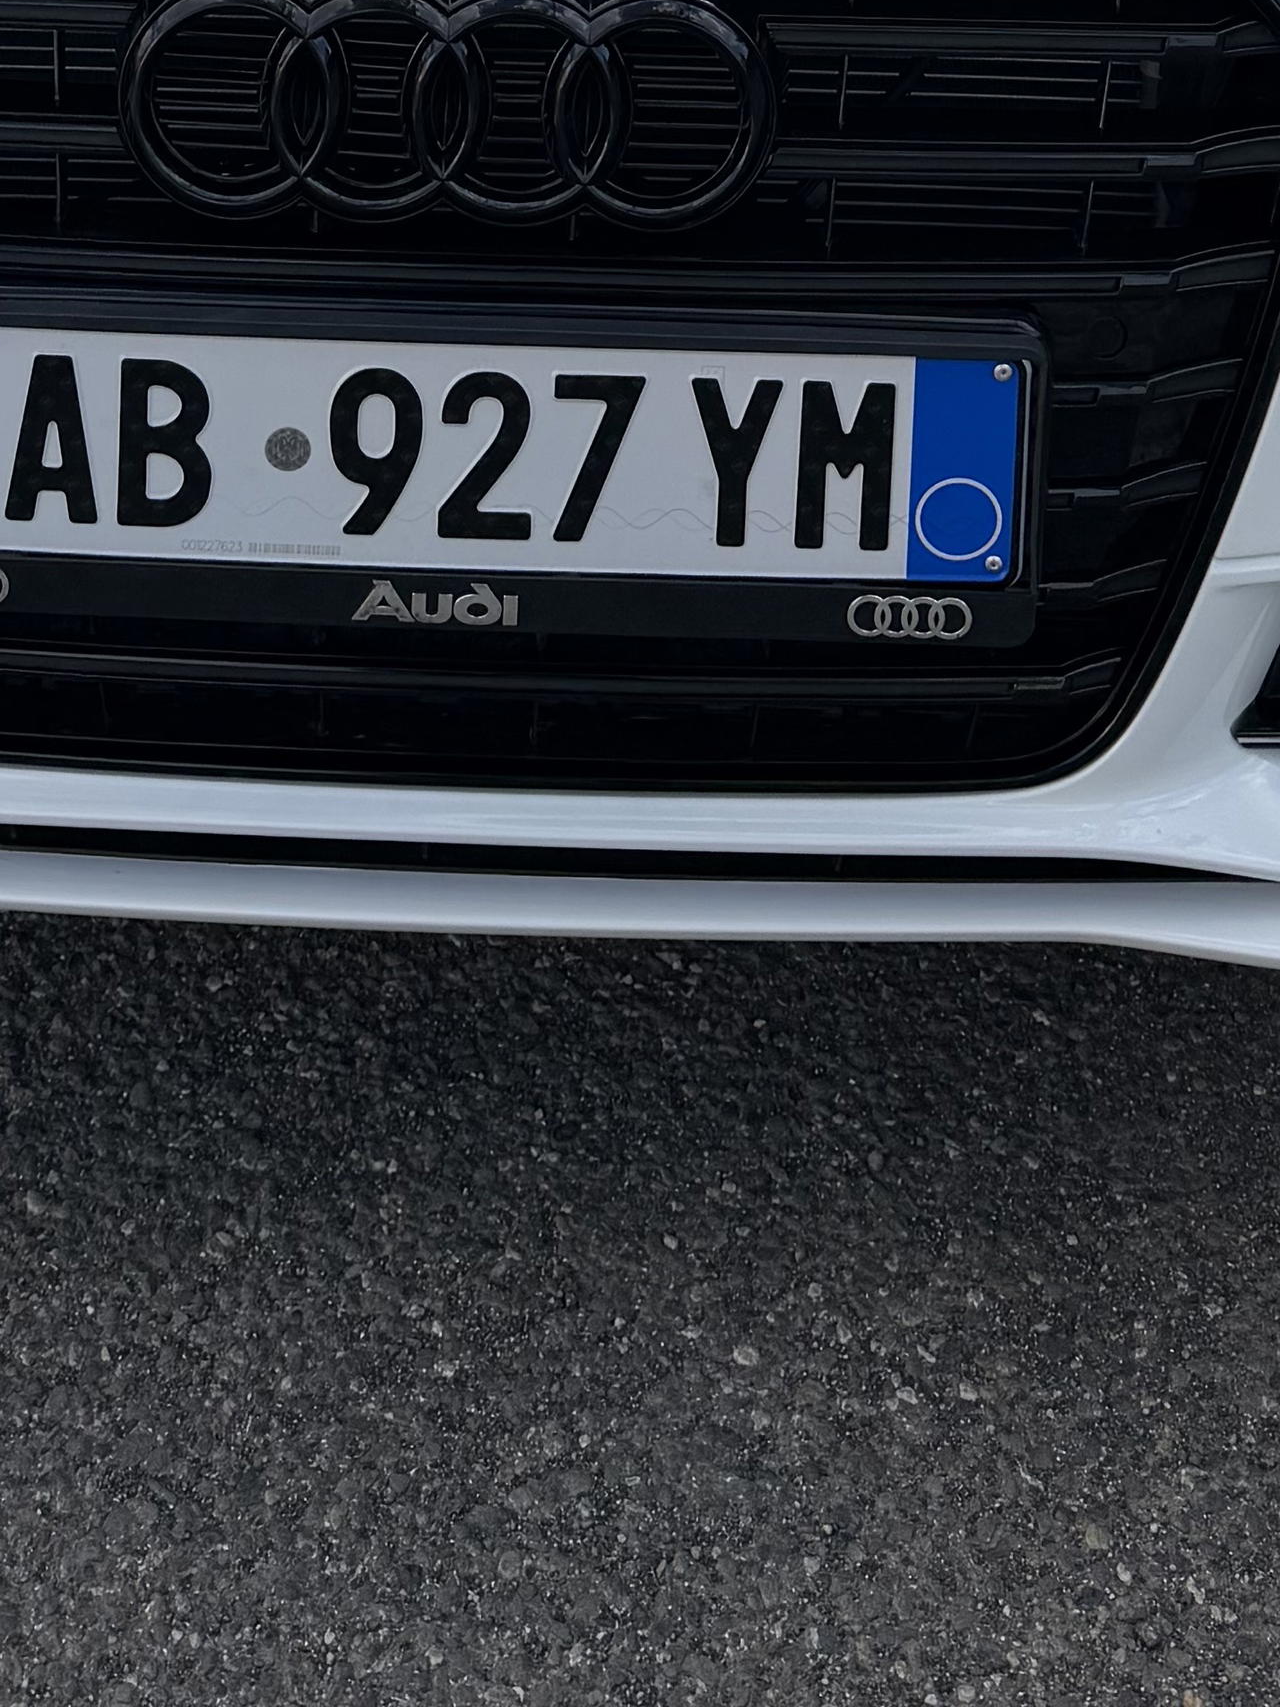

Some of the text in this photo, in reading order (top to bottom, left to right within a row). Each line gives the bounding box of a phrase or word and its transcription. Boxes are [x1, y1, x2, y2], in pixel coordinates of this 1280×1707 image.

[4, 354, 896, 550] AB 927 YM
[351, 579, 519, 626] Audi
